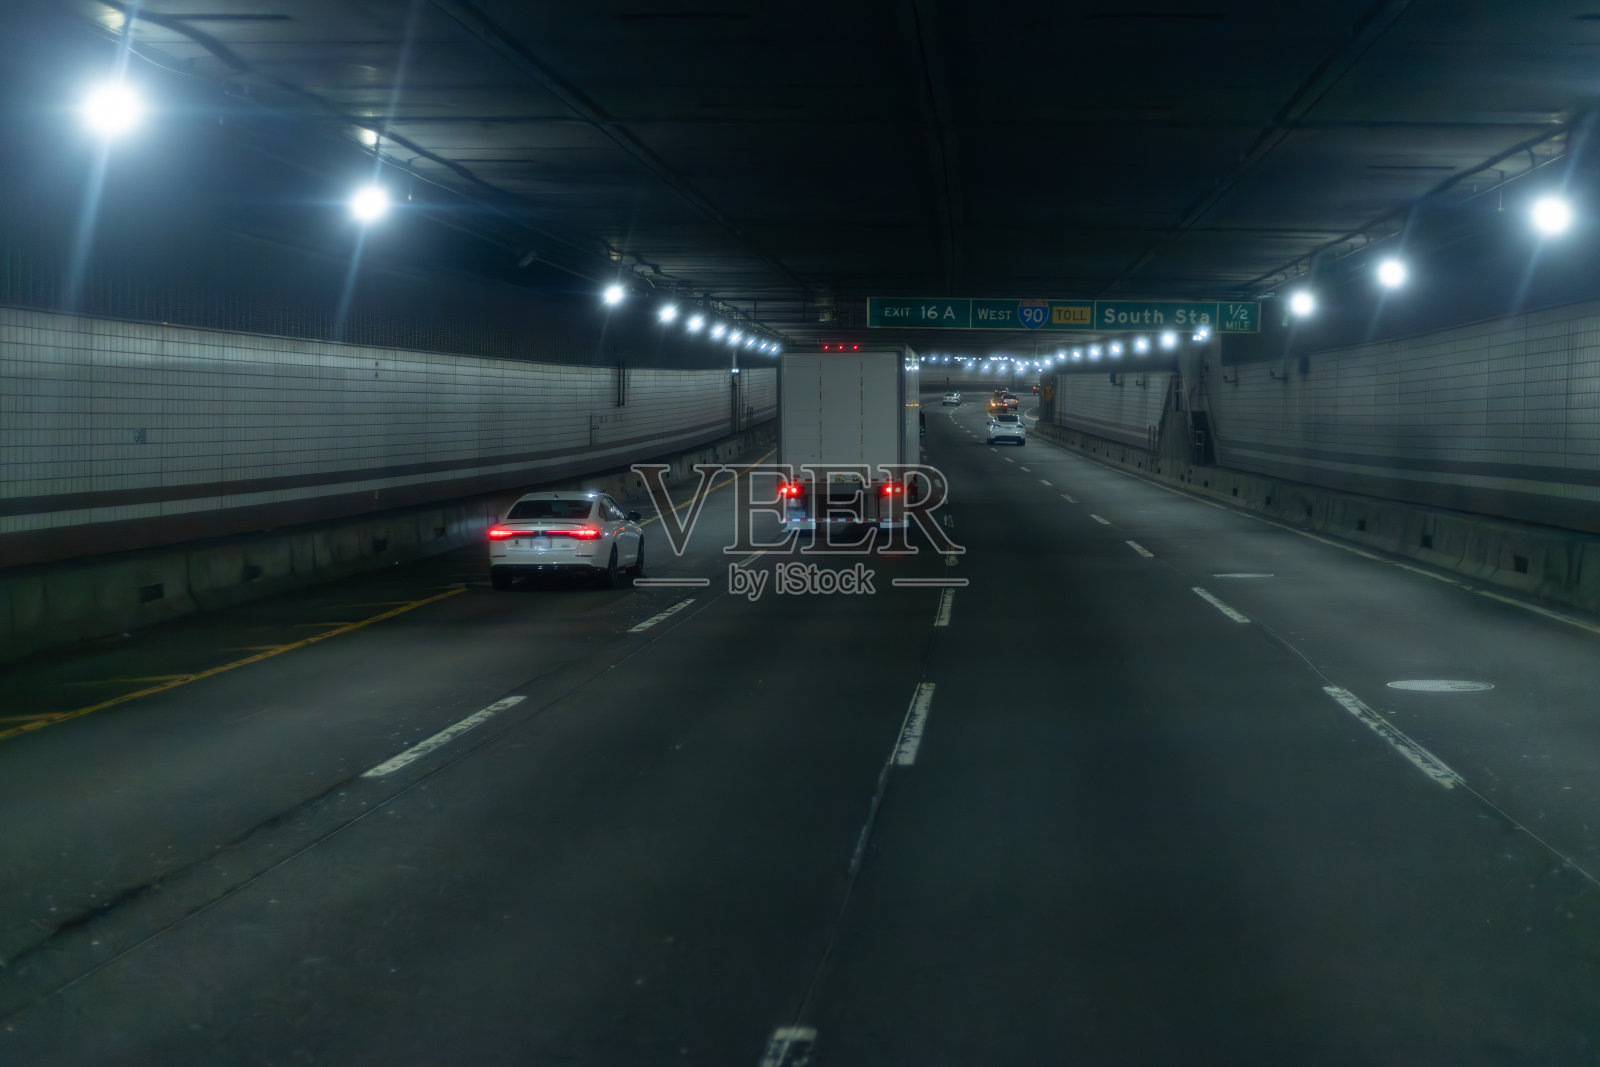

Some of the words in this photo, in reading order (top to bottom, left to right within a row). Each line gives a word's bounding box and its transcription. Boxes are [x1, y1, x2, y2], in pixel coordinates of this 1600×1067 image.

[884, 307, 911, 317] EXIT
[920, 305, 938, 319] 16
[943, 305, 957, 319] A
[977, 308, 1012, 320] WEST
[1022, 308, 1044, 323] 90
[1056, 309, 1087, 323] TOLL
[1103, 308, 1164, 324] South
[1175, 308, 1211, 325] Sta
[1225, 321, 1251, 331] MILE
